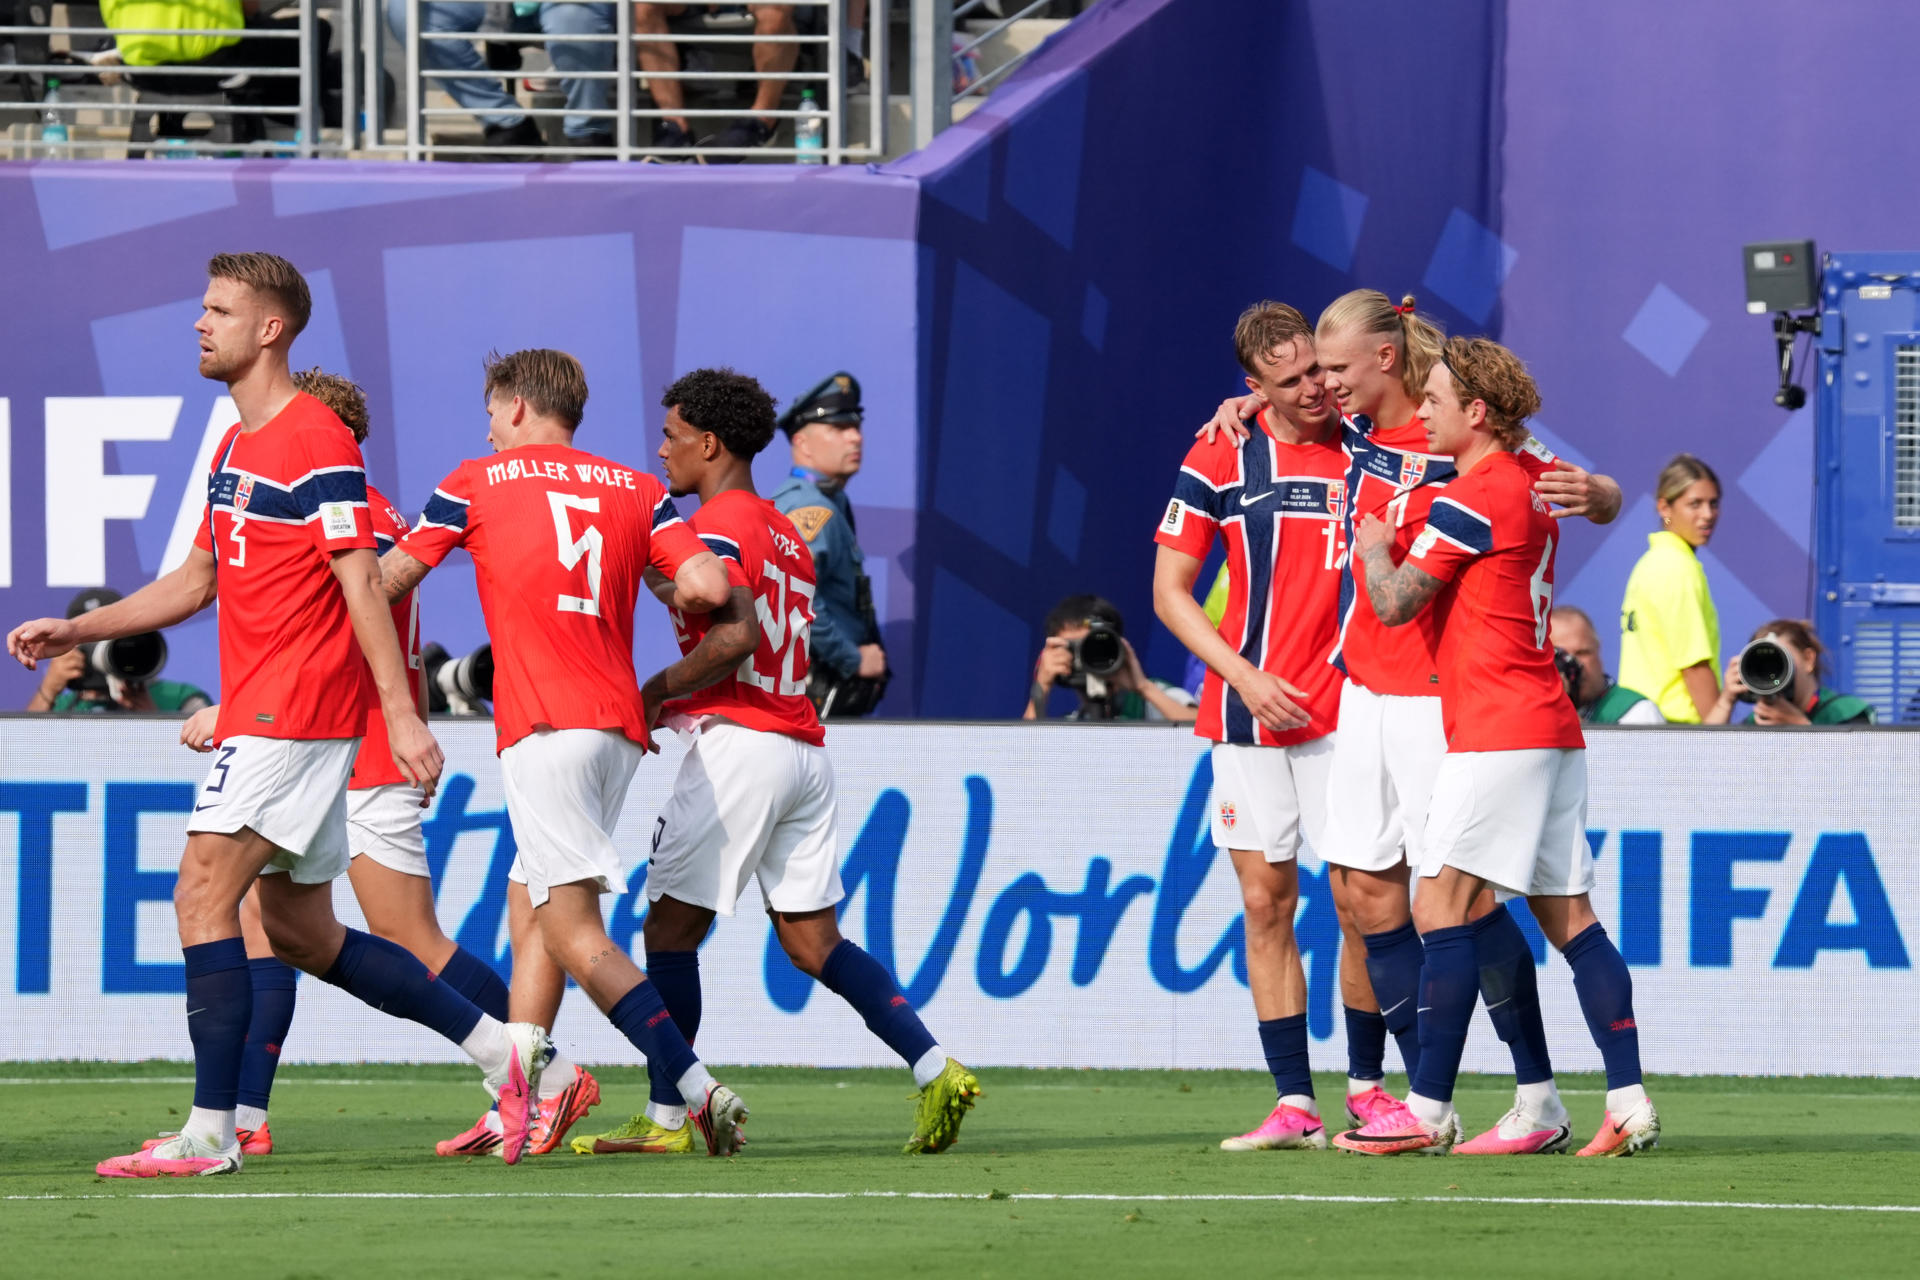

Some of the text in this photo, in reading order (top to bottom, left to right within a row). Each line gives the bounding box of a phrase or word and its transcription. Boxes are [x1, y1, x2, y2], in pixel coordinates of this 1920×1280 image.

[486, 459, 636, 490] MØLLER WOLFE
[228, 513, 246, 568] 3
[546, 490, 604, 618] 5
[1530, 533, 1553, 650] 6
[206, 746, 238, 794] 3
[1505, 829, 1912, 969] IFA
